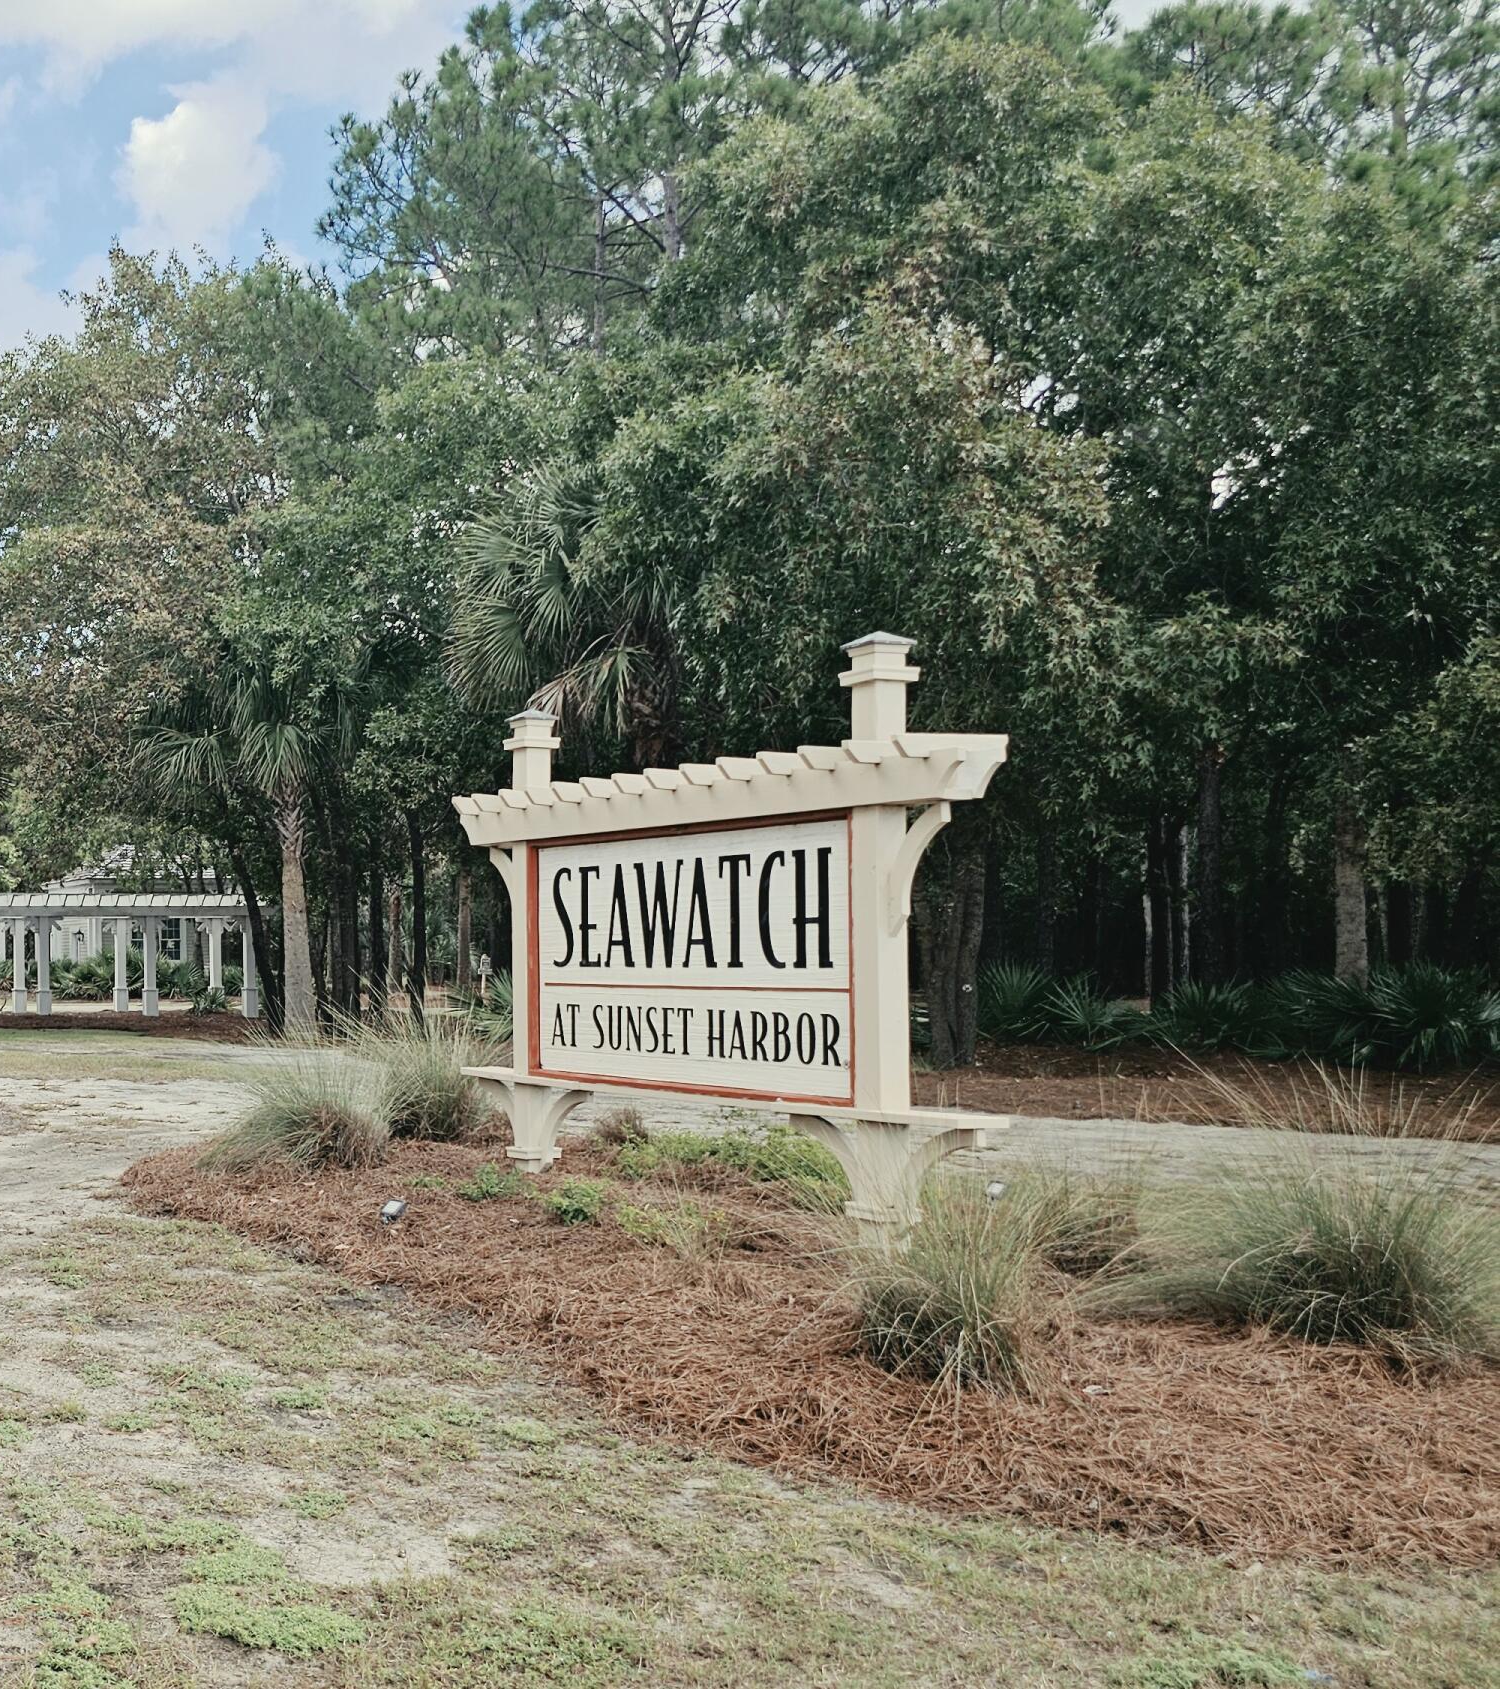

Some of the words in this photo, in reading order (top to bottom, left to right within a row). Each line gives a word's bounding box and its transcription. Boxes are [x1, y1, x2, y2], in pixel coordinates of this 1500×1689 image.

[553, 847, 833, 969] SEAWATCH
[552, 1003, 580, 1046] AT
[592, 1004, 694, 1055] SUNSET
[707, 1009, 841, 1067] HARBOR
